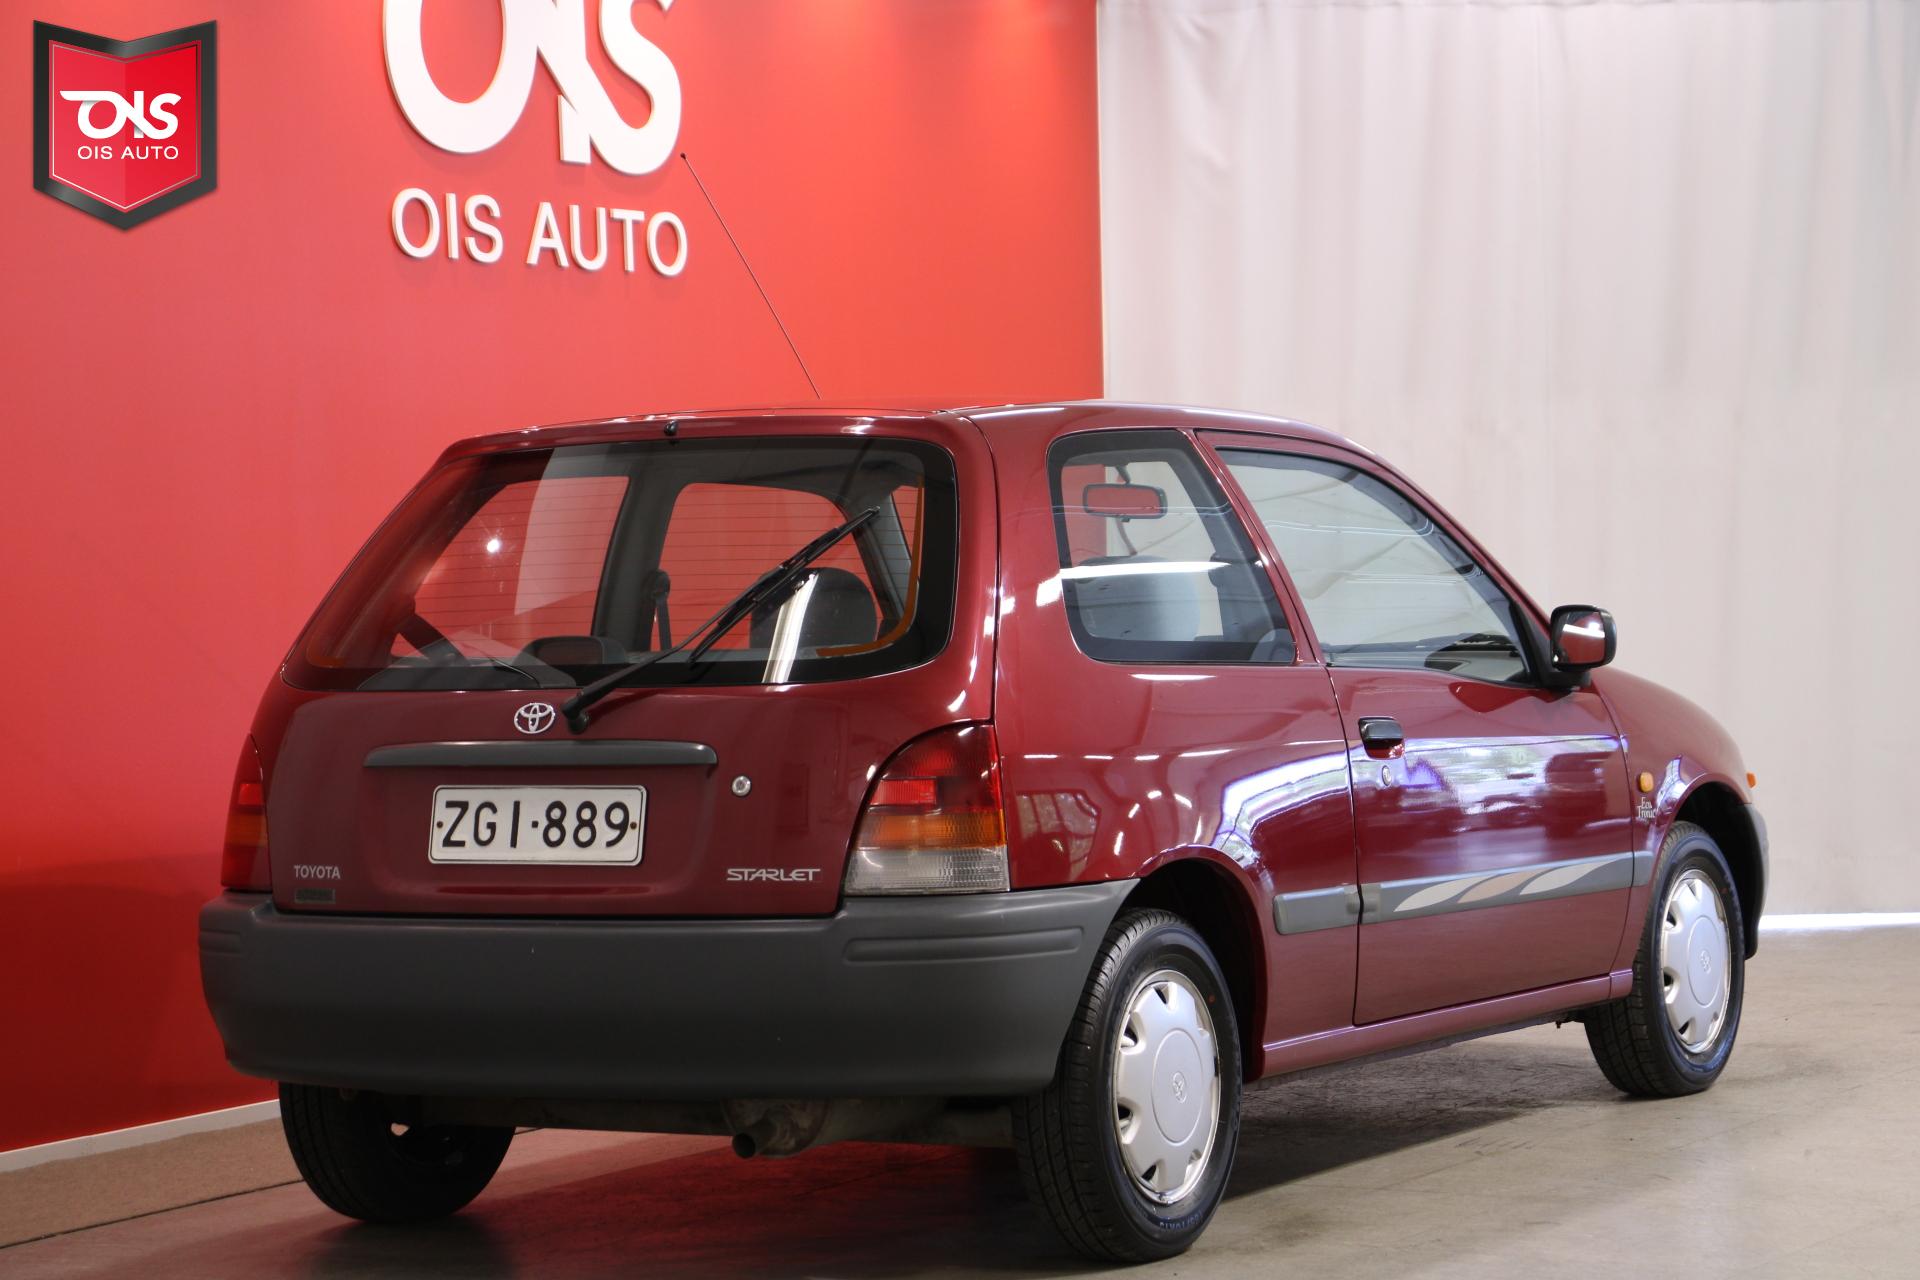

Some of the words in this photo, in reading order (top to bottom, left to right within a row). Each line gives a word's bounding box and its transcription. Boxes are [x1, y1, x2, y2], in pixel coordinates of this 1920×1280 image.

[383, 0, 682, 176] OIS
[391, 187, 503, 264] OIS
[526, 201, 688, 277] AUTO
[441, 800, 631, 849] ZGI-889
[293, 864, 341, 880] TOYOTA
[726, 868, 821, 881] STARLET
